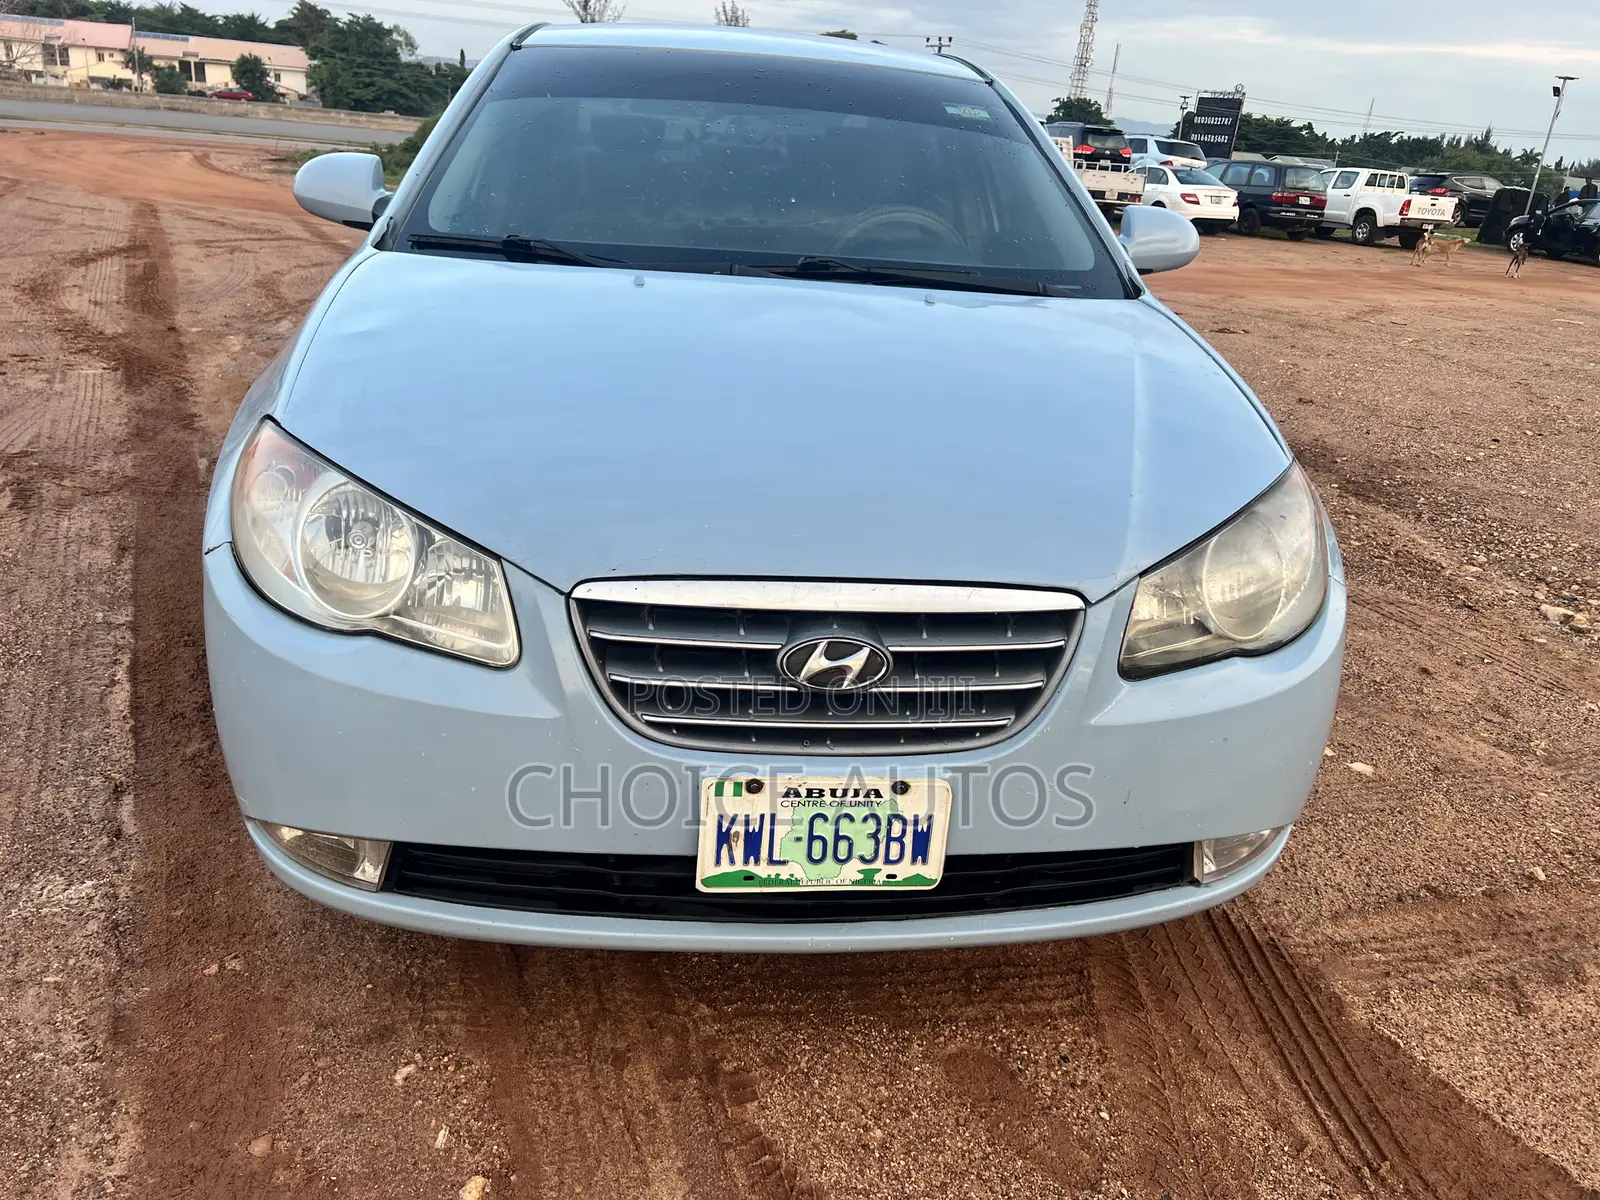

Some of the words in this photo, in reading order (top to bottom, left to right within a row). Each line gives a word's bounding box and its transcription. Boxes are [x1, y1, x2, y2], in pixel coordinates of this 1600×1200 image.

[1417, 207, 1446, 217] TOYOTA
[781, 787, 884, 799] ABUJA
[780, 800, 826, 808] CENTRE
[829, 800, 847, 808] OF
[849, 800, 882, 808] UNITY
